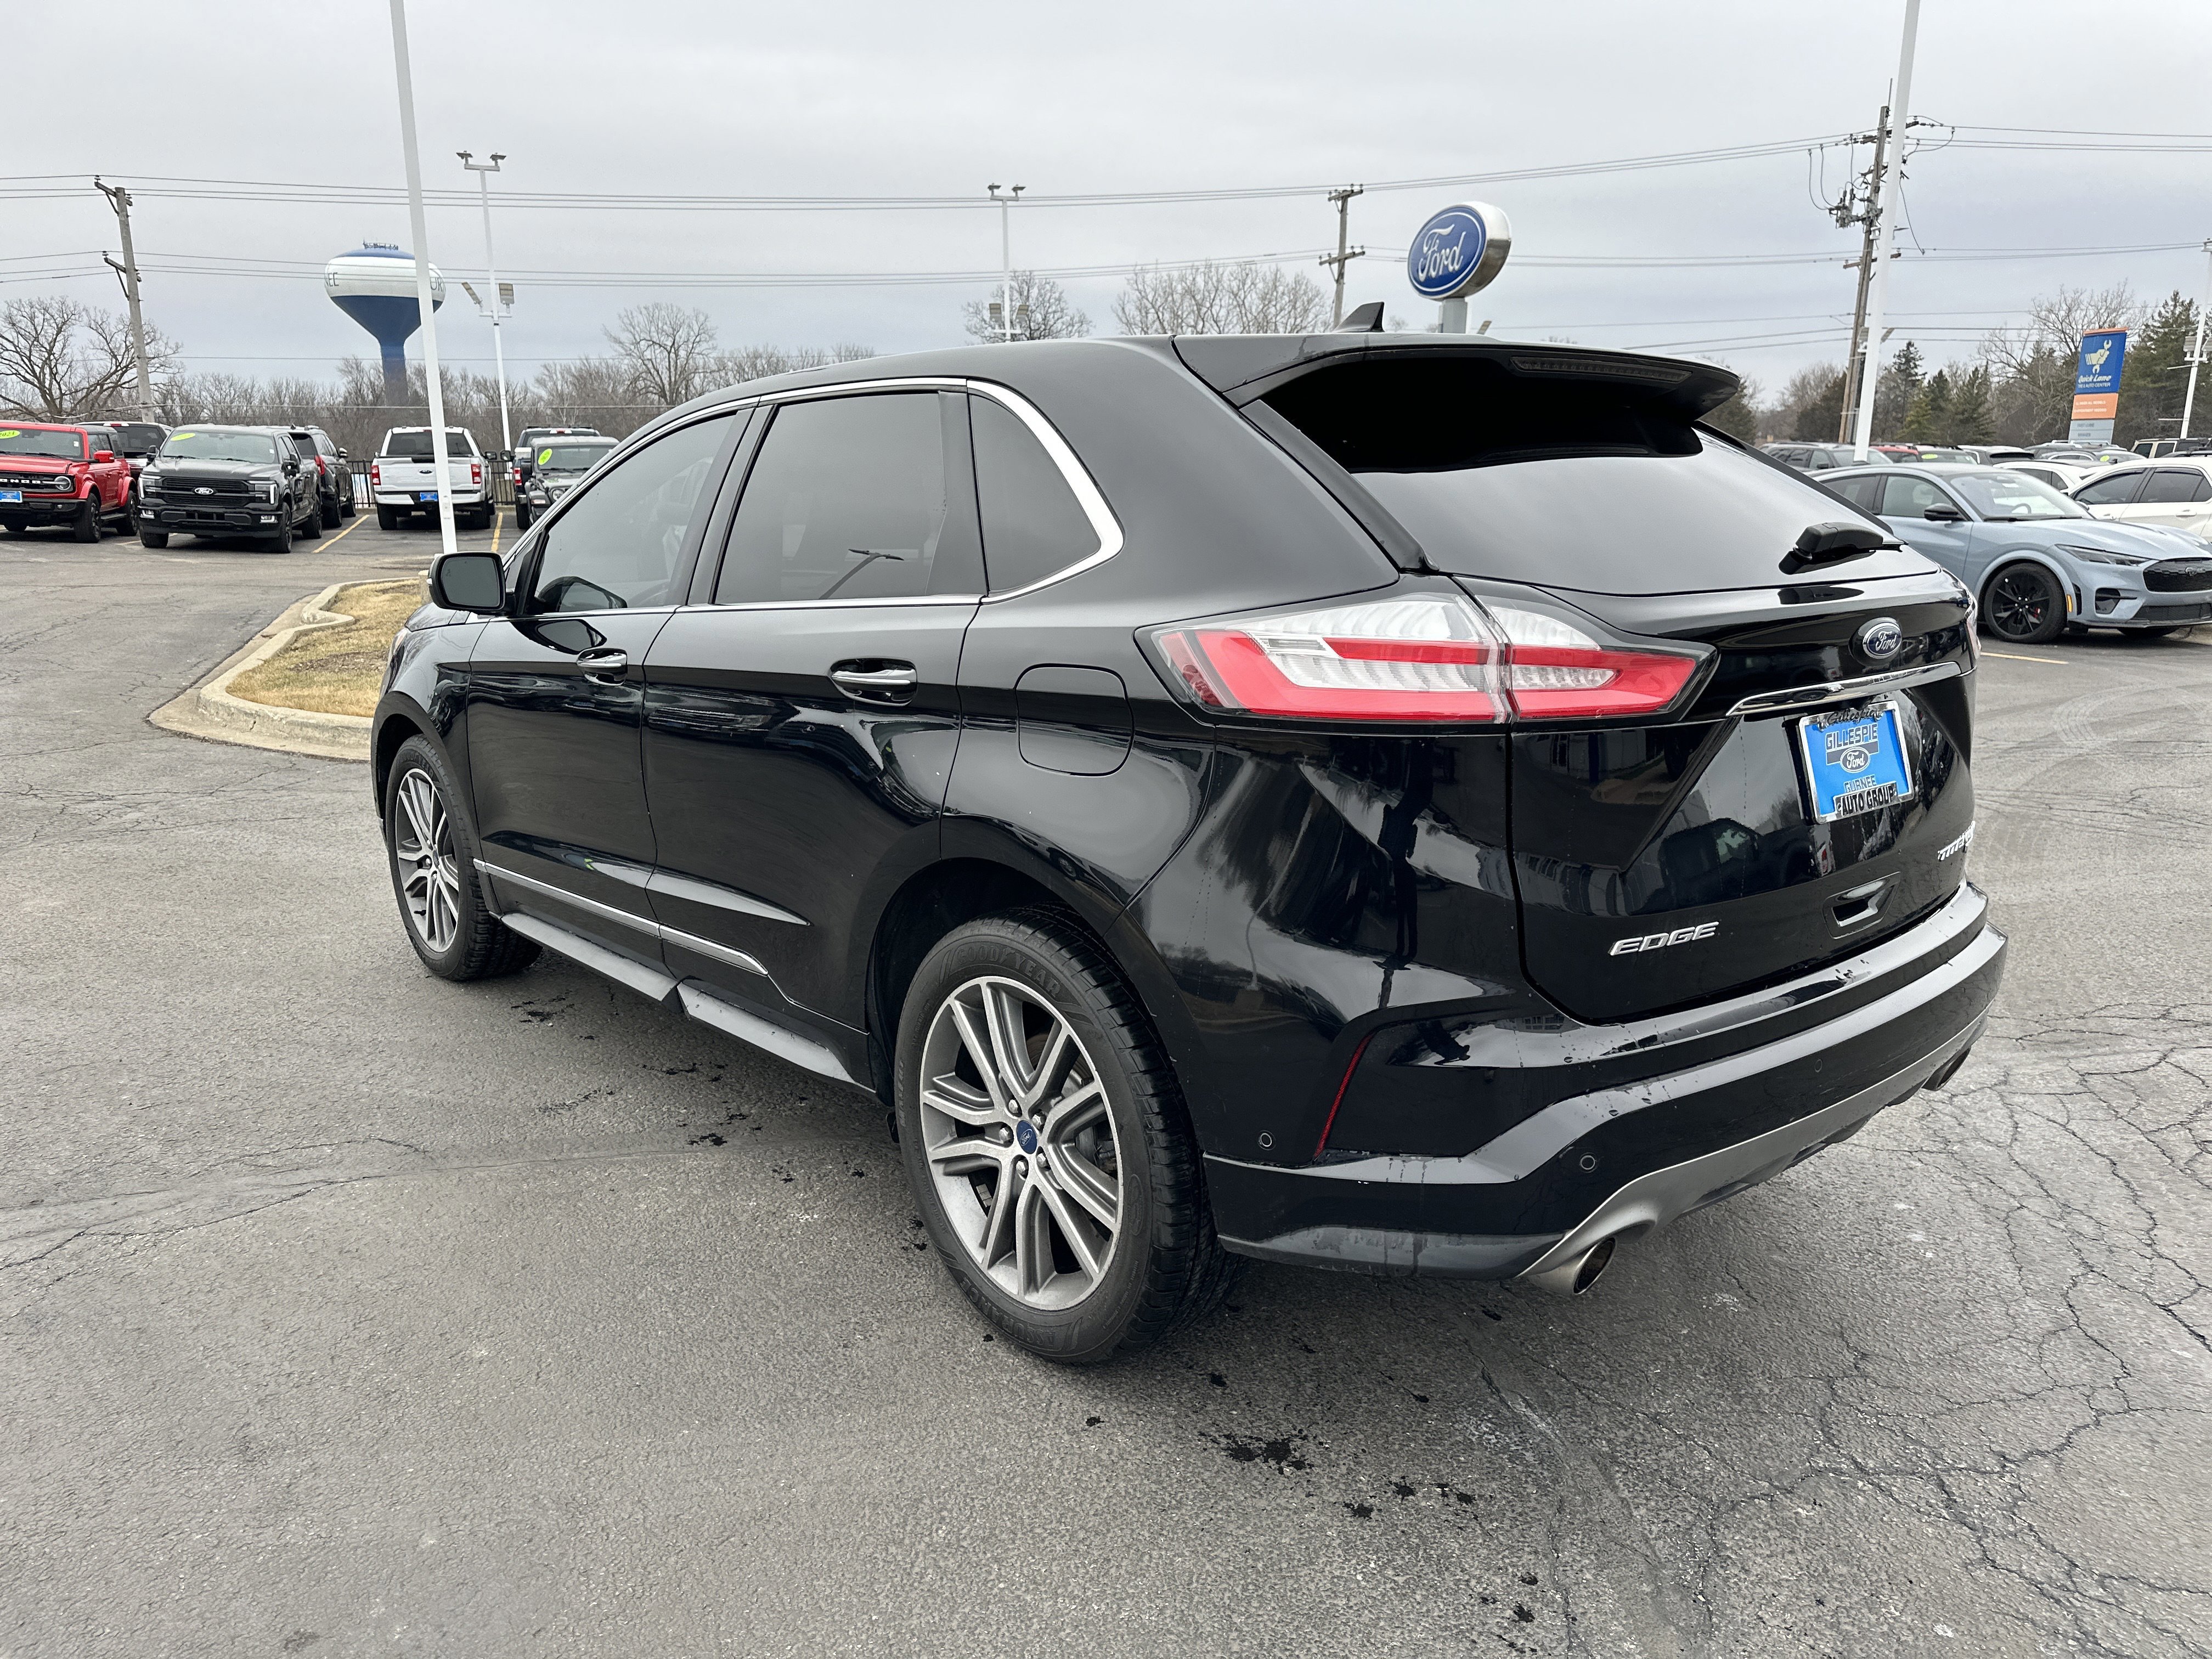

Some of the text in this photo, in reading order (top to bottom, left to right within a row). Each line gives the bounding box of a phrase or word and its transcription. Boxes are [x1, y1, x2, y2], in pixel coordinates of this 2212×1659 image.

[1418, 224, 1466, 282] Ford
[1876, 631, 1897, 651] Ford
[1825, 723, 1878, 751] GILLESPIE
[1847, 751, 1865, 769] Ford
[1844, 775, 1877, 793] GURNEE
[1841, 785, 1894, 816] AUTO GROUP
[1608, 921, 1719, 956] EDGE
